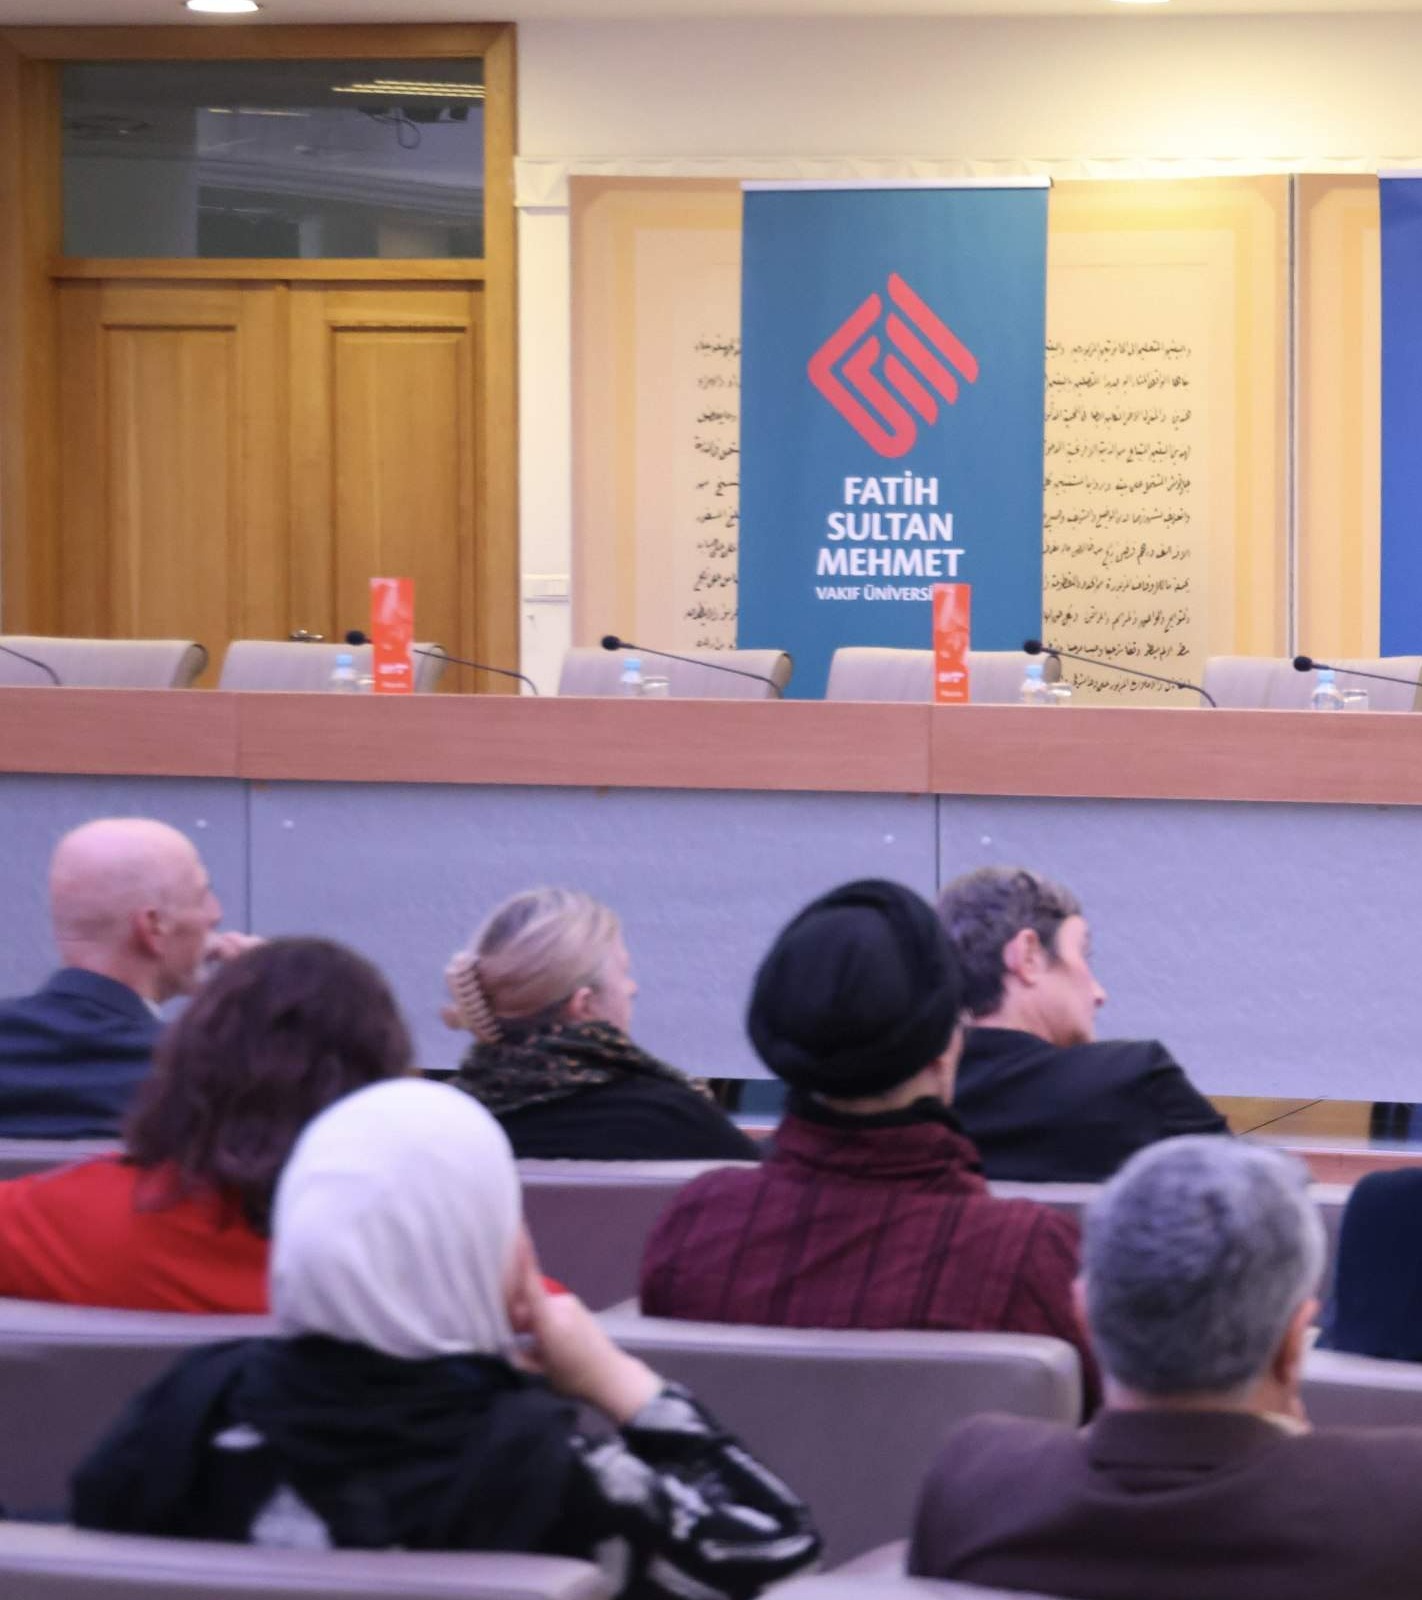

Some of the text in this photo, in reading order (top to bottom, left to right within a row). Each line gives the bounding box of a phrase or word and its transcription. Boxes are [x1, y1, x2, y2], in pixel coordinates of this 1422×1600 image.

[844, 470, 939, 506] FATİH
[826, 512, 954, 541] SULTAN
[815, 547, 966, 577] MEHMET
[815, 584, 934, 601] VAKIF ÜNİVERSİ
